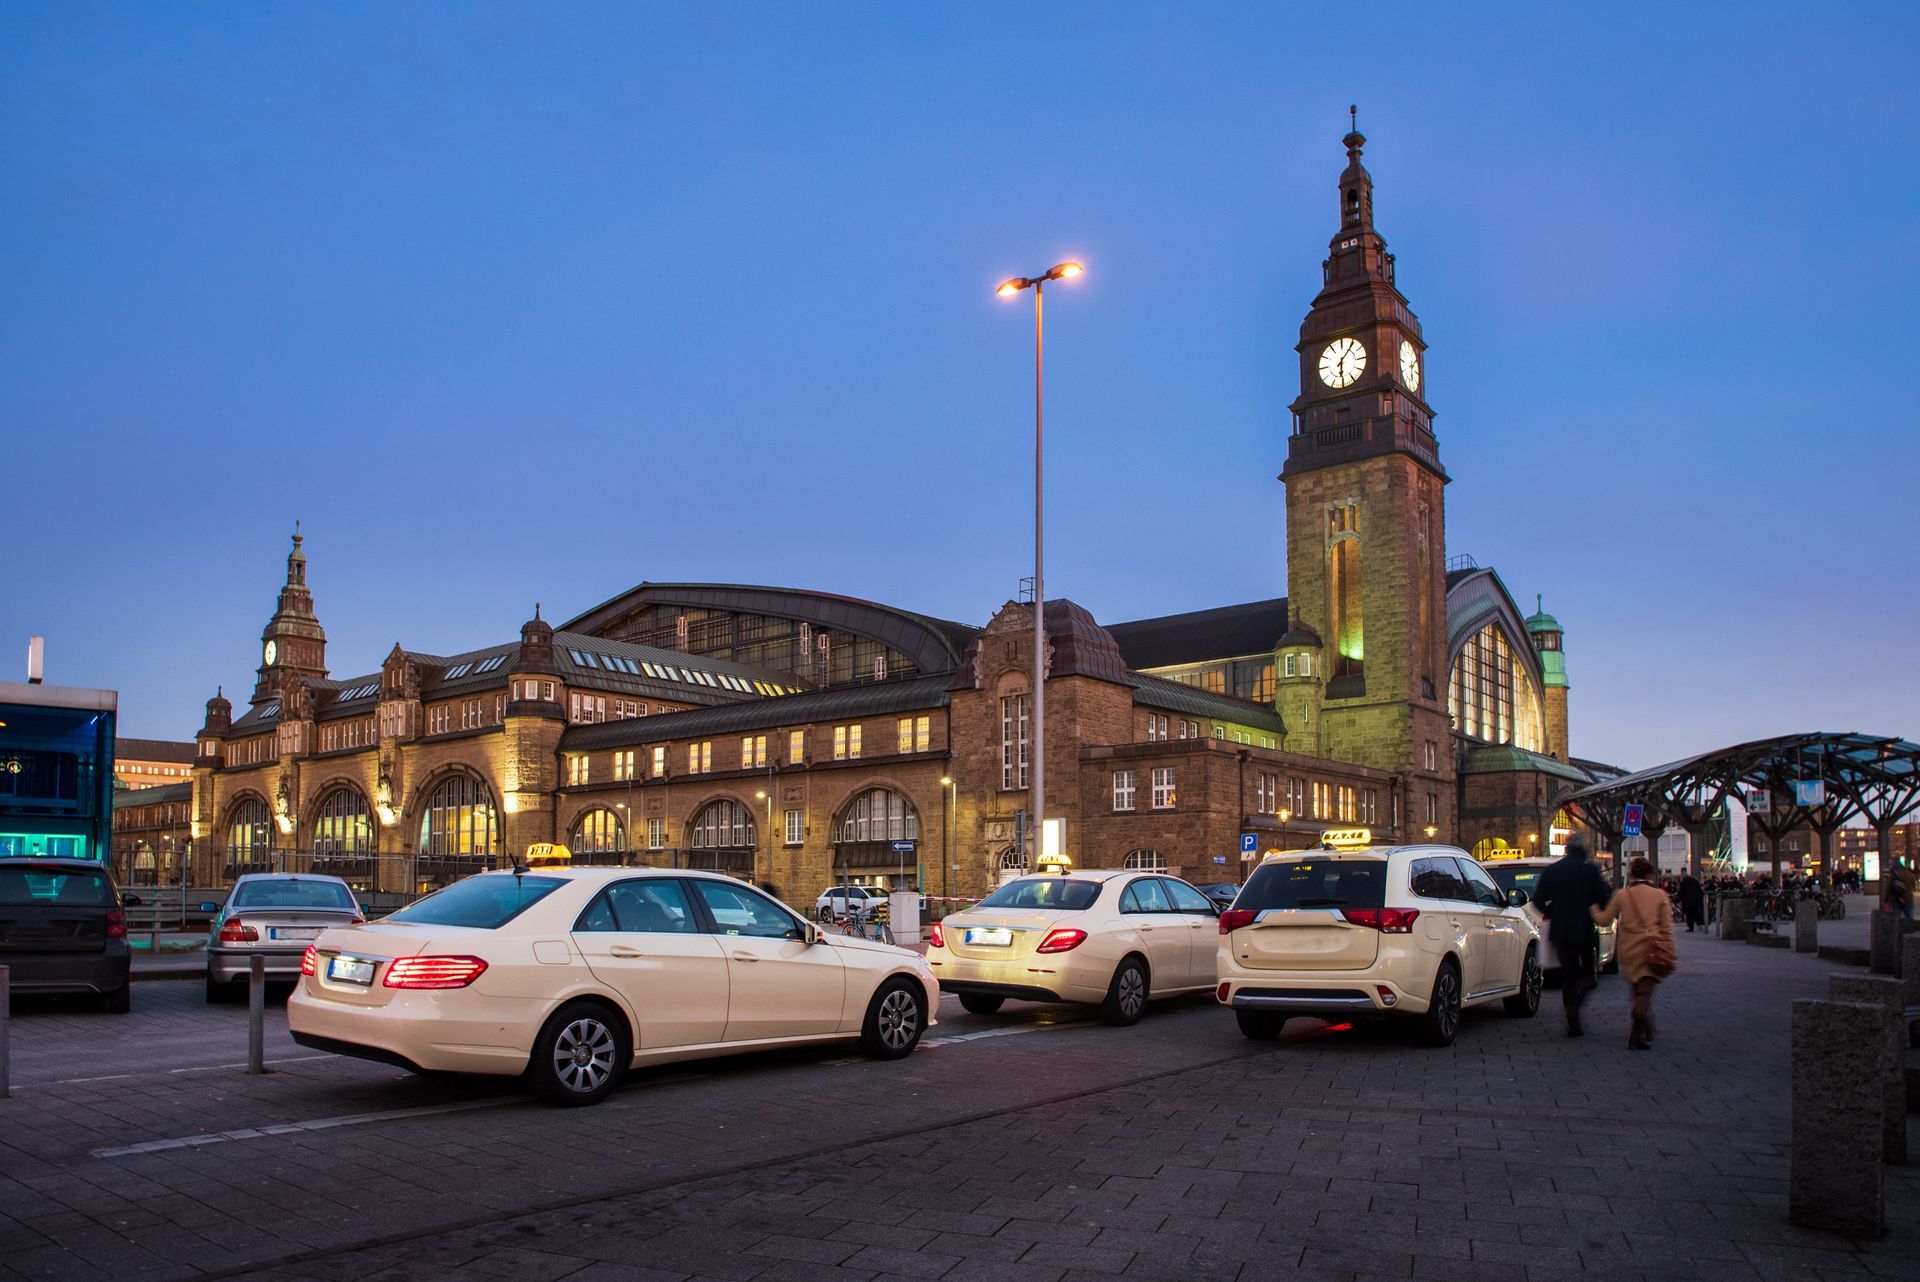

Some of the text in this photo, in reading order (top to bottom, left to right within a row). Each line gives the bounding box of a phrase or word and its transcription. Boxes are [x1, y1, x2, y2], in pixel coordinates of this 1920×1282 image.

[1800, 783, 1820, 803] U
[1244, 836, 1253, 849] P
[531, 845, 553, 855] TAXI
